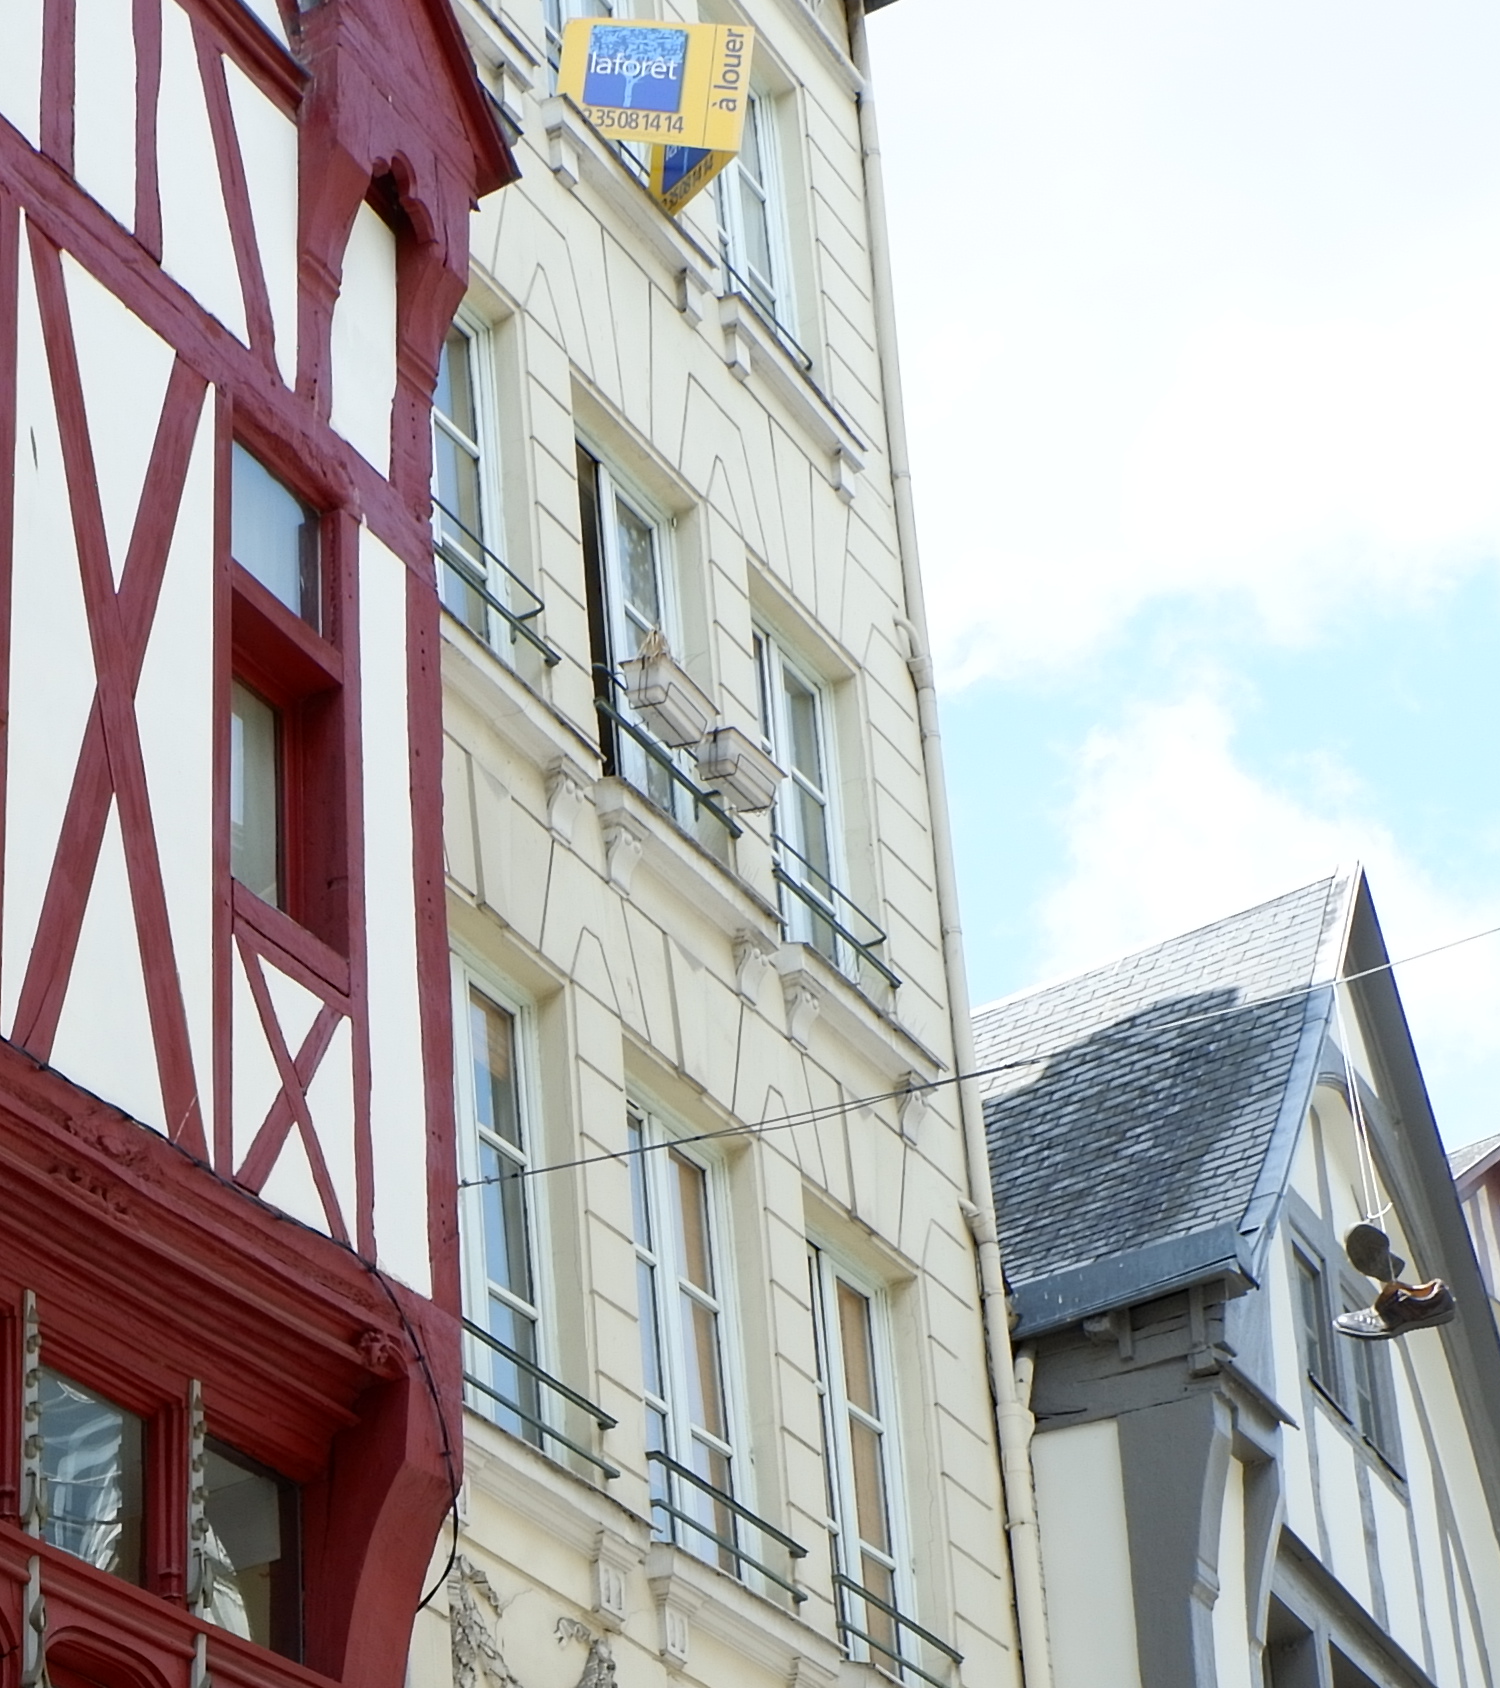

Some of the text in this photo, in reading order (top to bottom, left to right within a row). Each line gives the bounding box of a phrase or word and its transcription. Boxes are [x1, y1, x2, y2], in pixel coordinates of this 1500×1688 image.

[590, 51, 678, 81] laforêt
[712, 28, 744, 112] à louer
